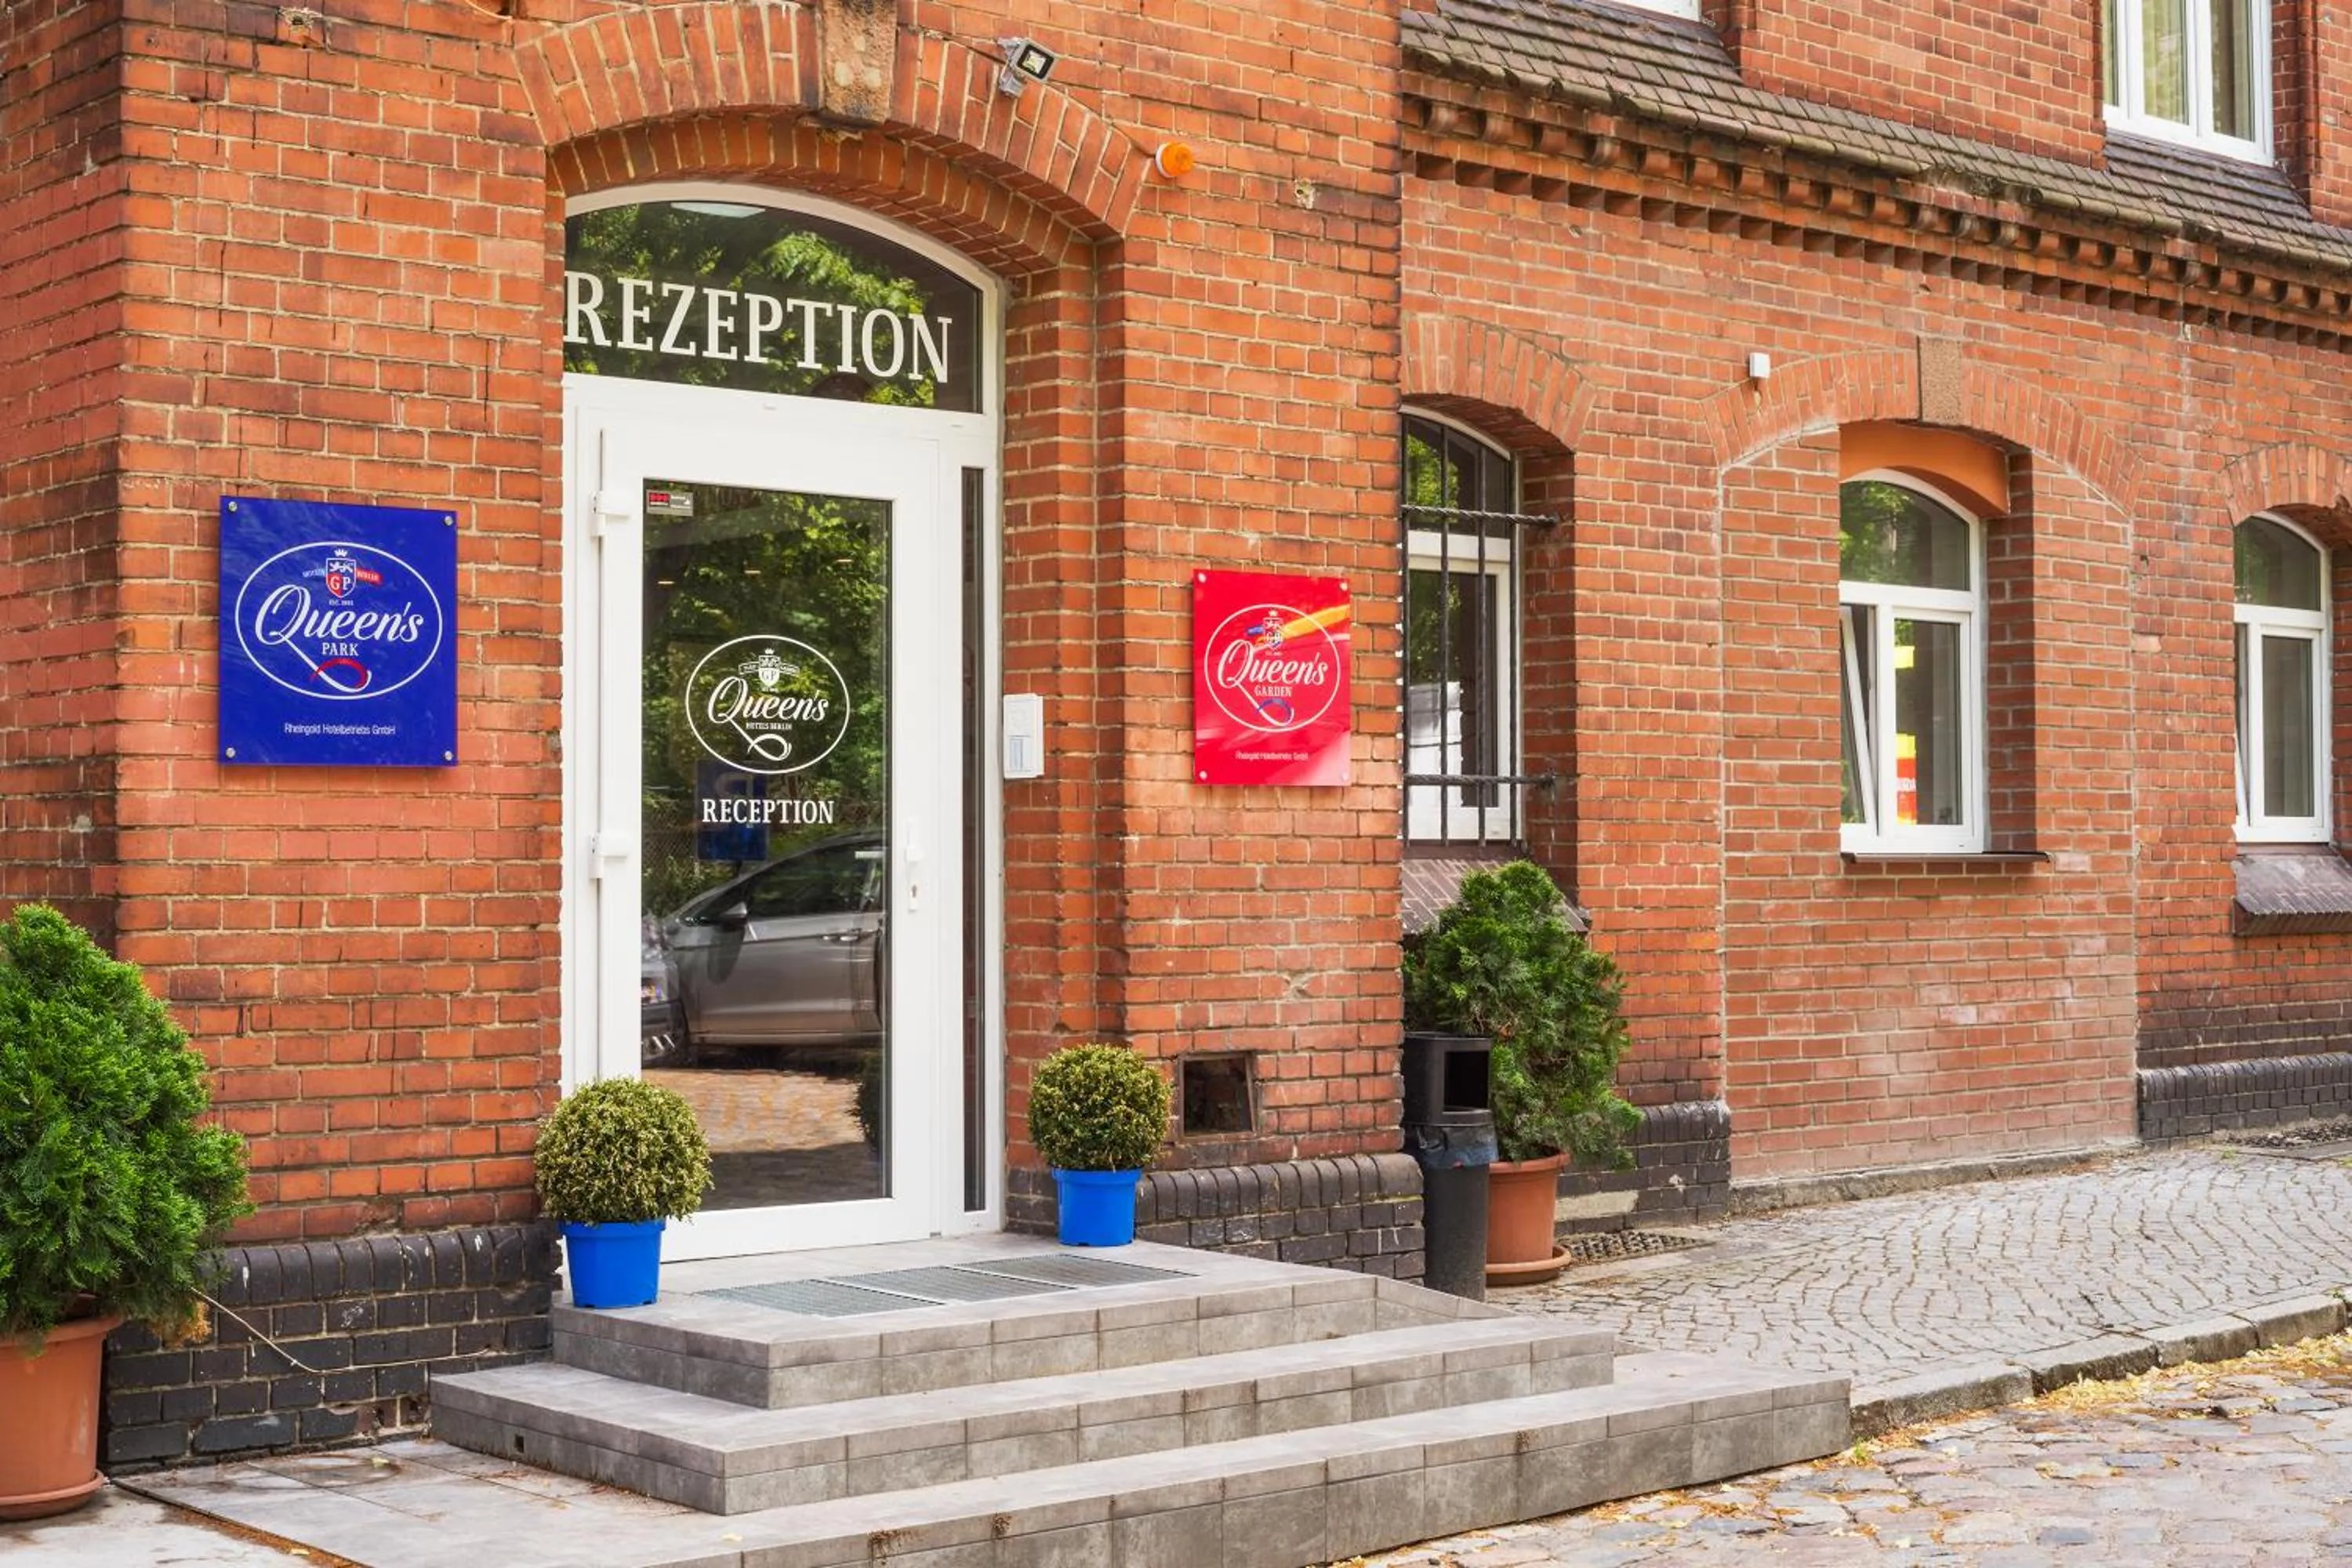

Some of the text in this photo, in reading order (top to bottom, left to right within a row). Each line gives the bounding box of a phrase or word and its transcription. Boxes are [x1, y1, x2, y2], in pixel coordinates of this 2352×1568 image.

[564, 270, 953, 384] REZEPTION
[255, 584, 424, 692] Queen's
[321, 642, 359, 656] PARK
[708, 676, 829, 760] Queen's
[1217, 639, 1328, 726] Queen's
[1254, 684, 1293, 697] GARDEN
[702, 798, 835, 824] RECEPTION
